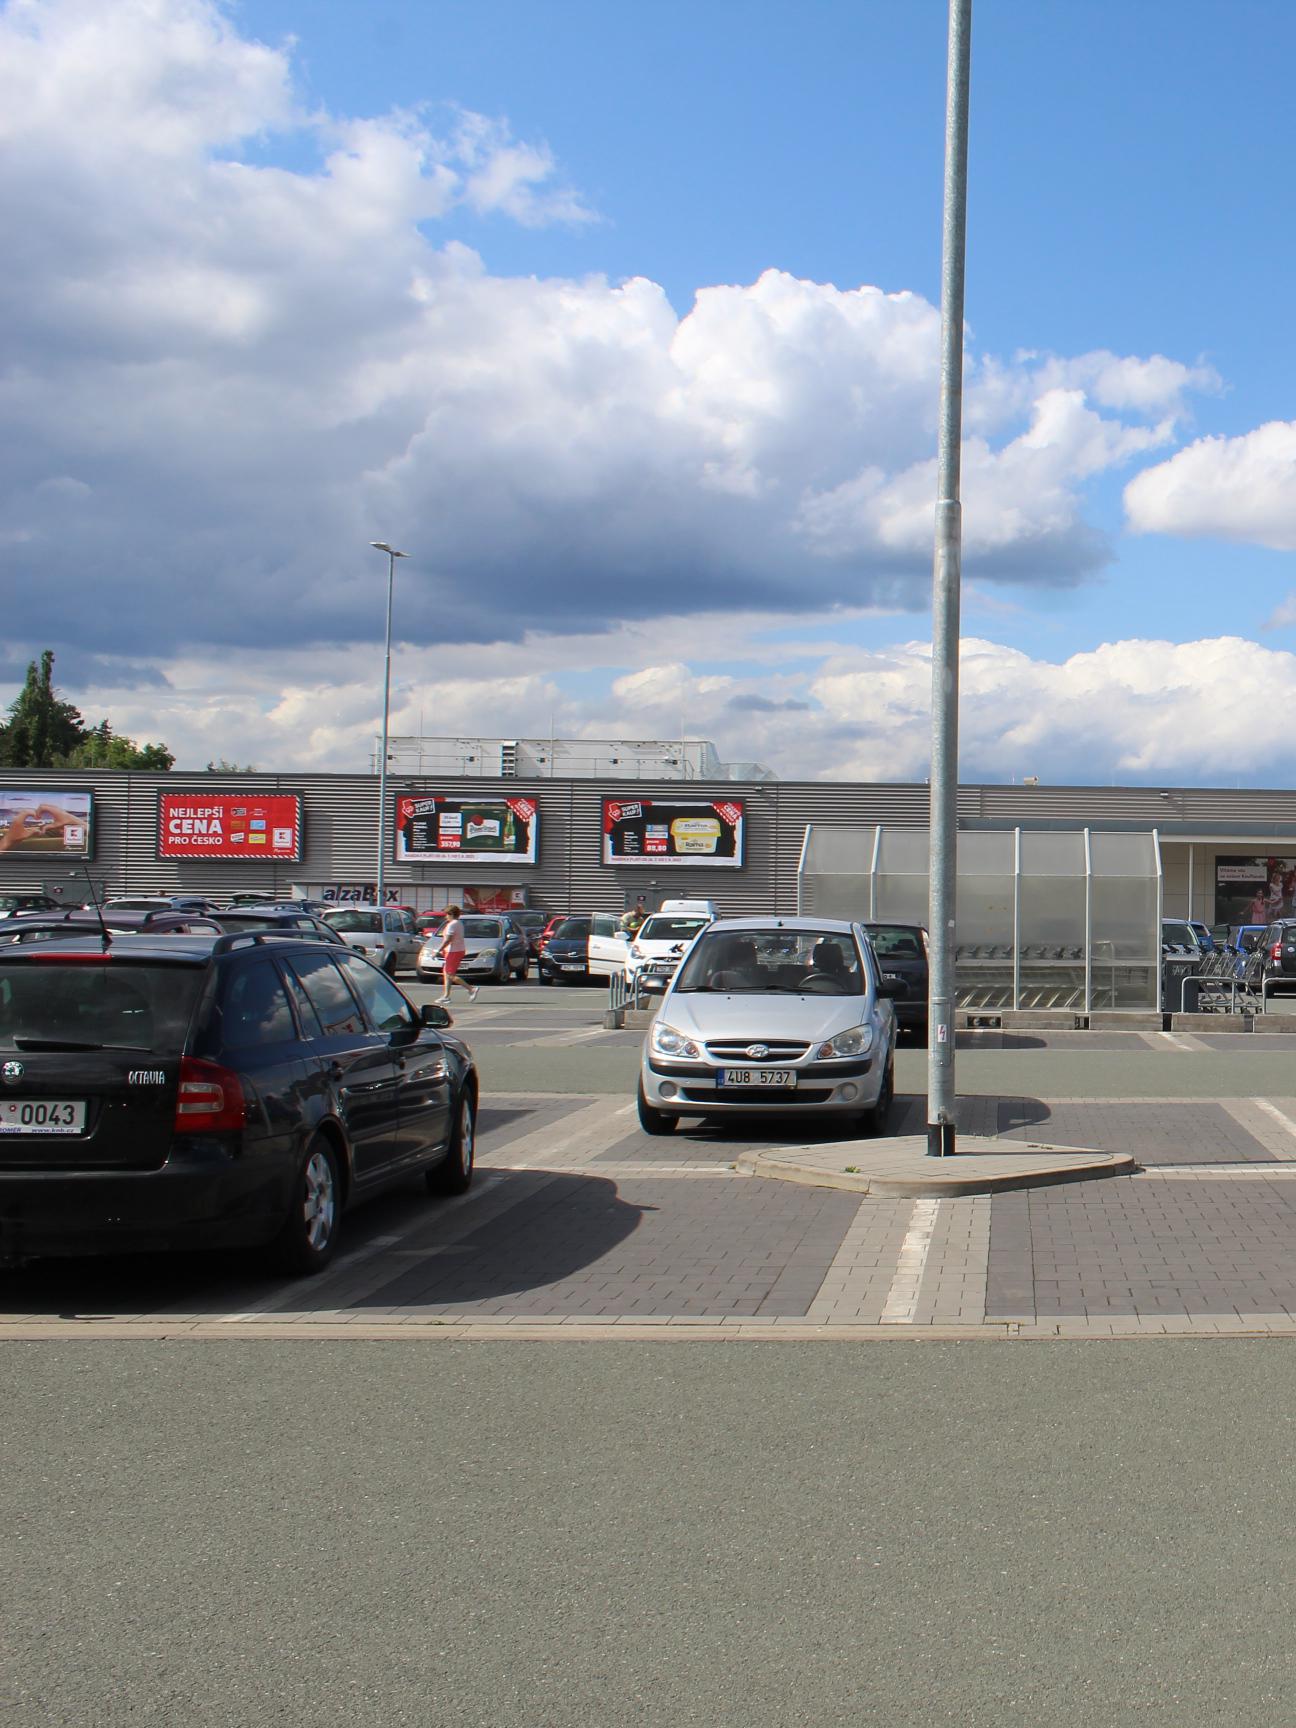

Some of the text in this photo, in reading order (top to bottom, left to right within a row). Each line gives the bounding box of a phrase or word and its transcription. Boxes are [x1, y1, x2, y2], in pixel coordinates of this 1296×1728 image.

[169, 806, 223, 818] NEJLEPŠÍ
[168, 819, 223, 834] CENA
[168, 835, 223, 845] PRO ČESKO
[323, 886, 399, 902] alzaBx
[128, 1070, 166, 1085] OCTAVIA
[727, 1071, 791, 1084] 4U8 5737
[21, 1104, 75, 1125] 0043
